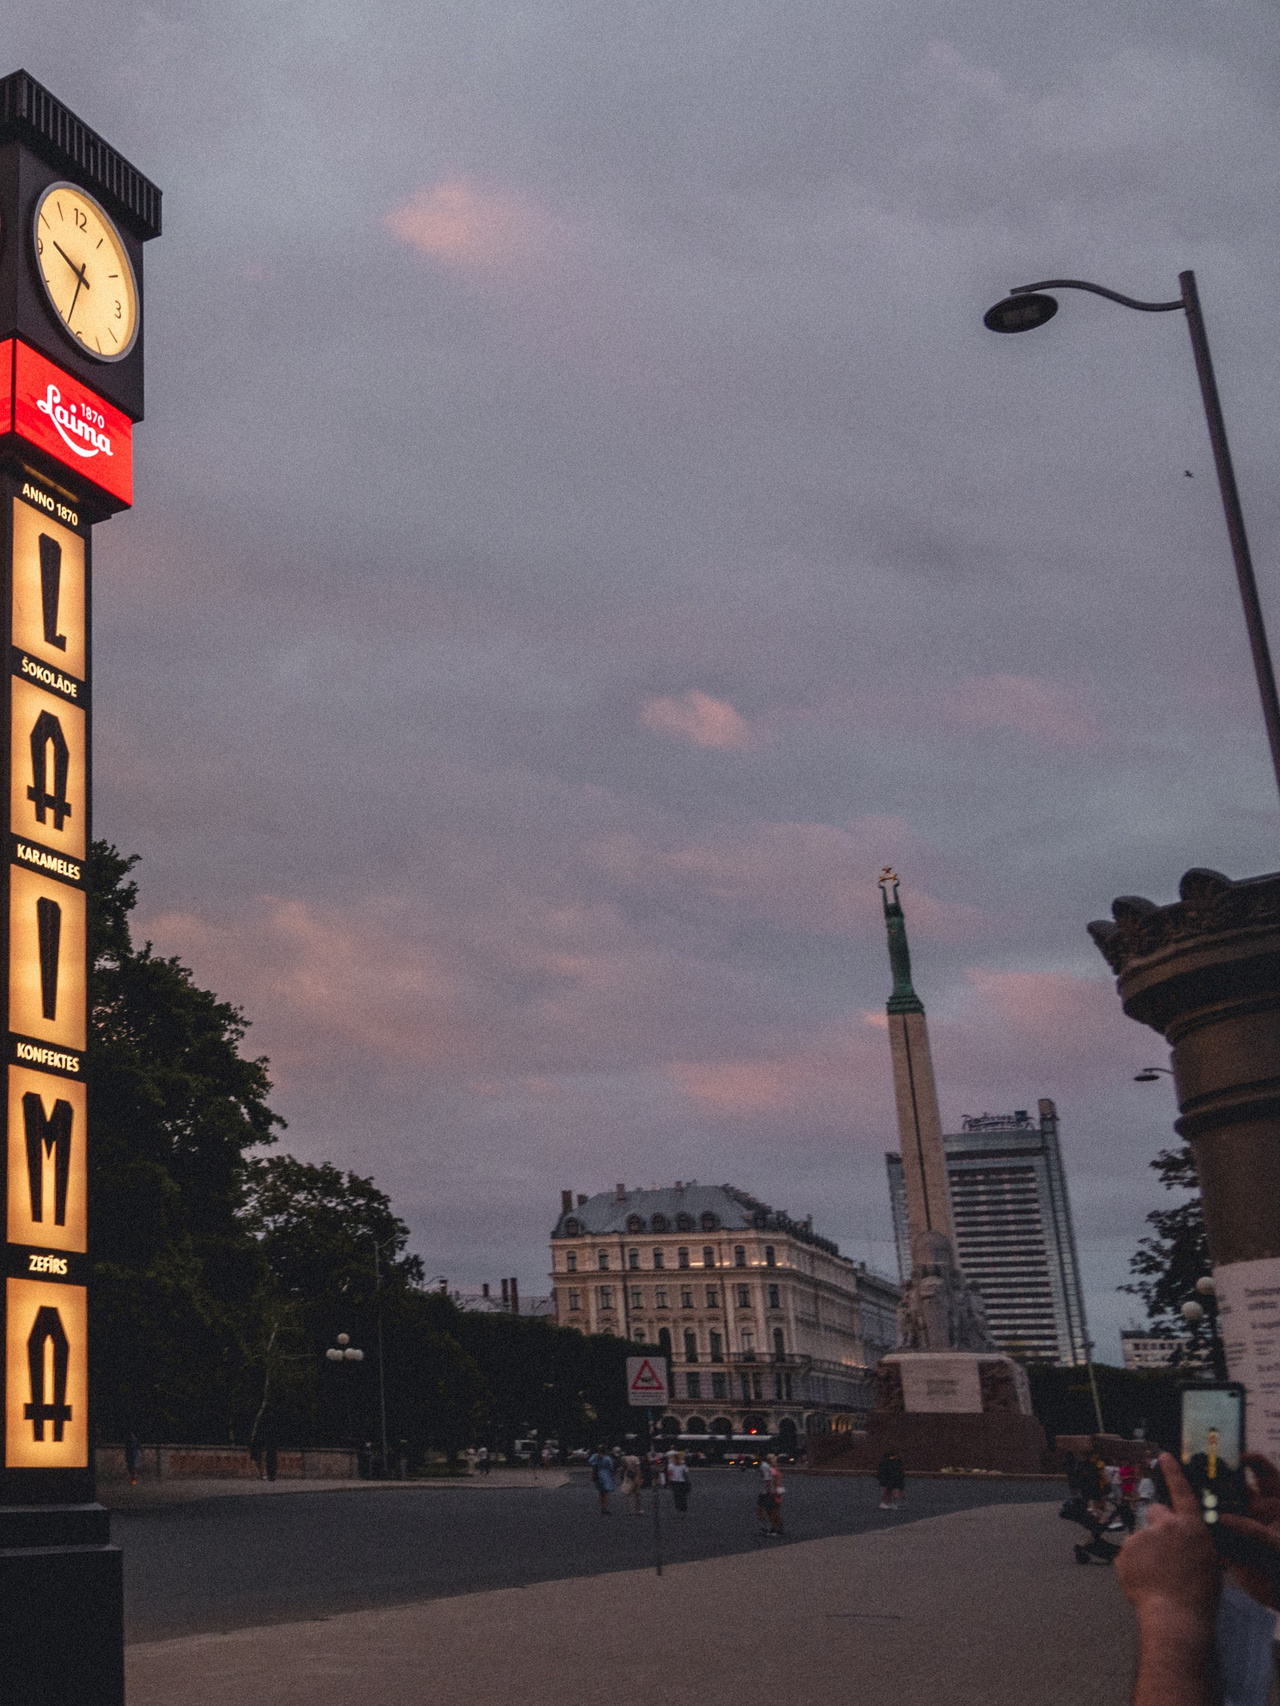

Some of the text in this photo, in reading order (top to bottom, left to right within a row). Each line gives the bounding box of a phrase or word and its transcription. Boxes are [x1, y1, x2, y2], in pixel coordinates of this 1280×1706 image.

[73, 207, 88, 234] 12
[113, 300, 122, 319] 3
[36, 384, 114, 458] Laima
[80, 403, 105, 429] 1870
[22, 482, 79, 527] ANNO 1870
[21, 656, 78, 698] ŠOKOLĀDE
[16, 843, 81, 881] KARAMELES
[16, 1042, 80, 1073] KONFEKTES
[28, 1254, 68, 1275] ZEFĪRS
